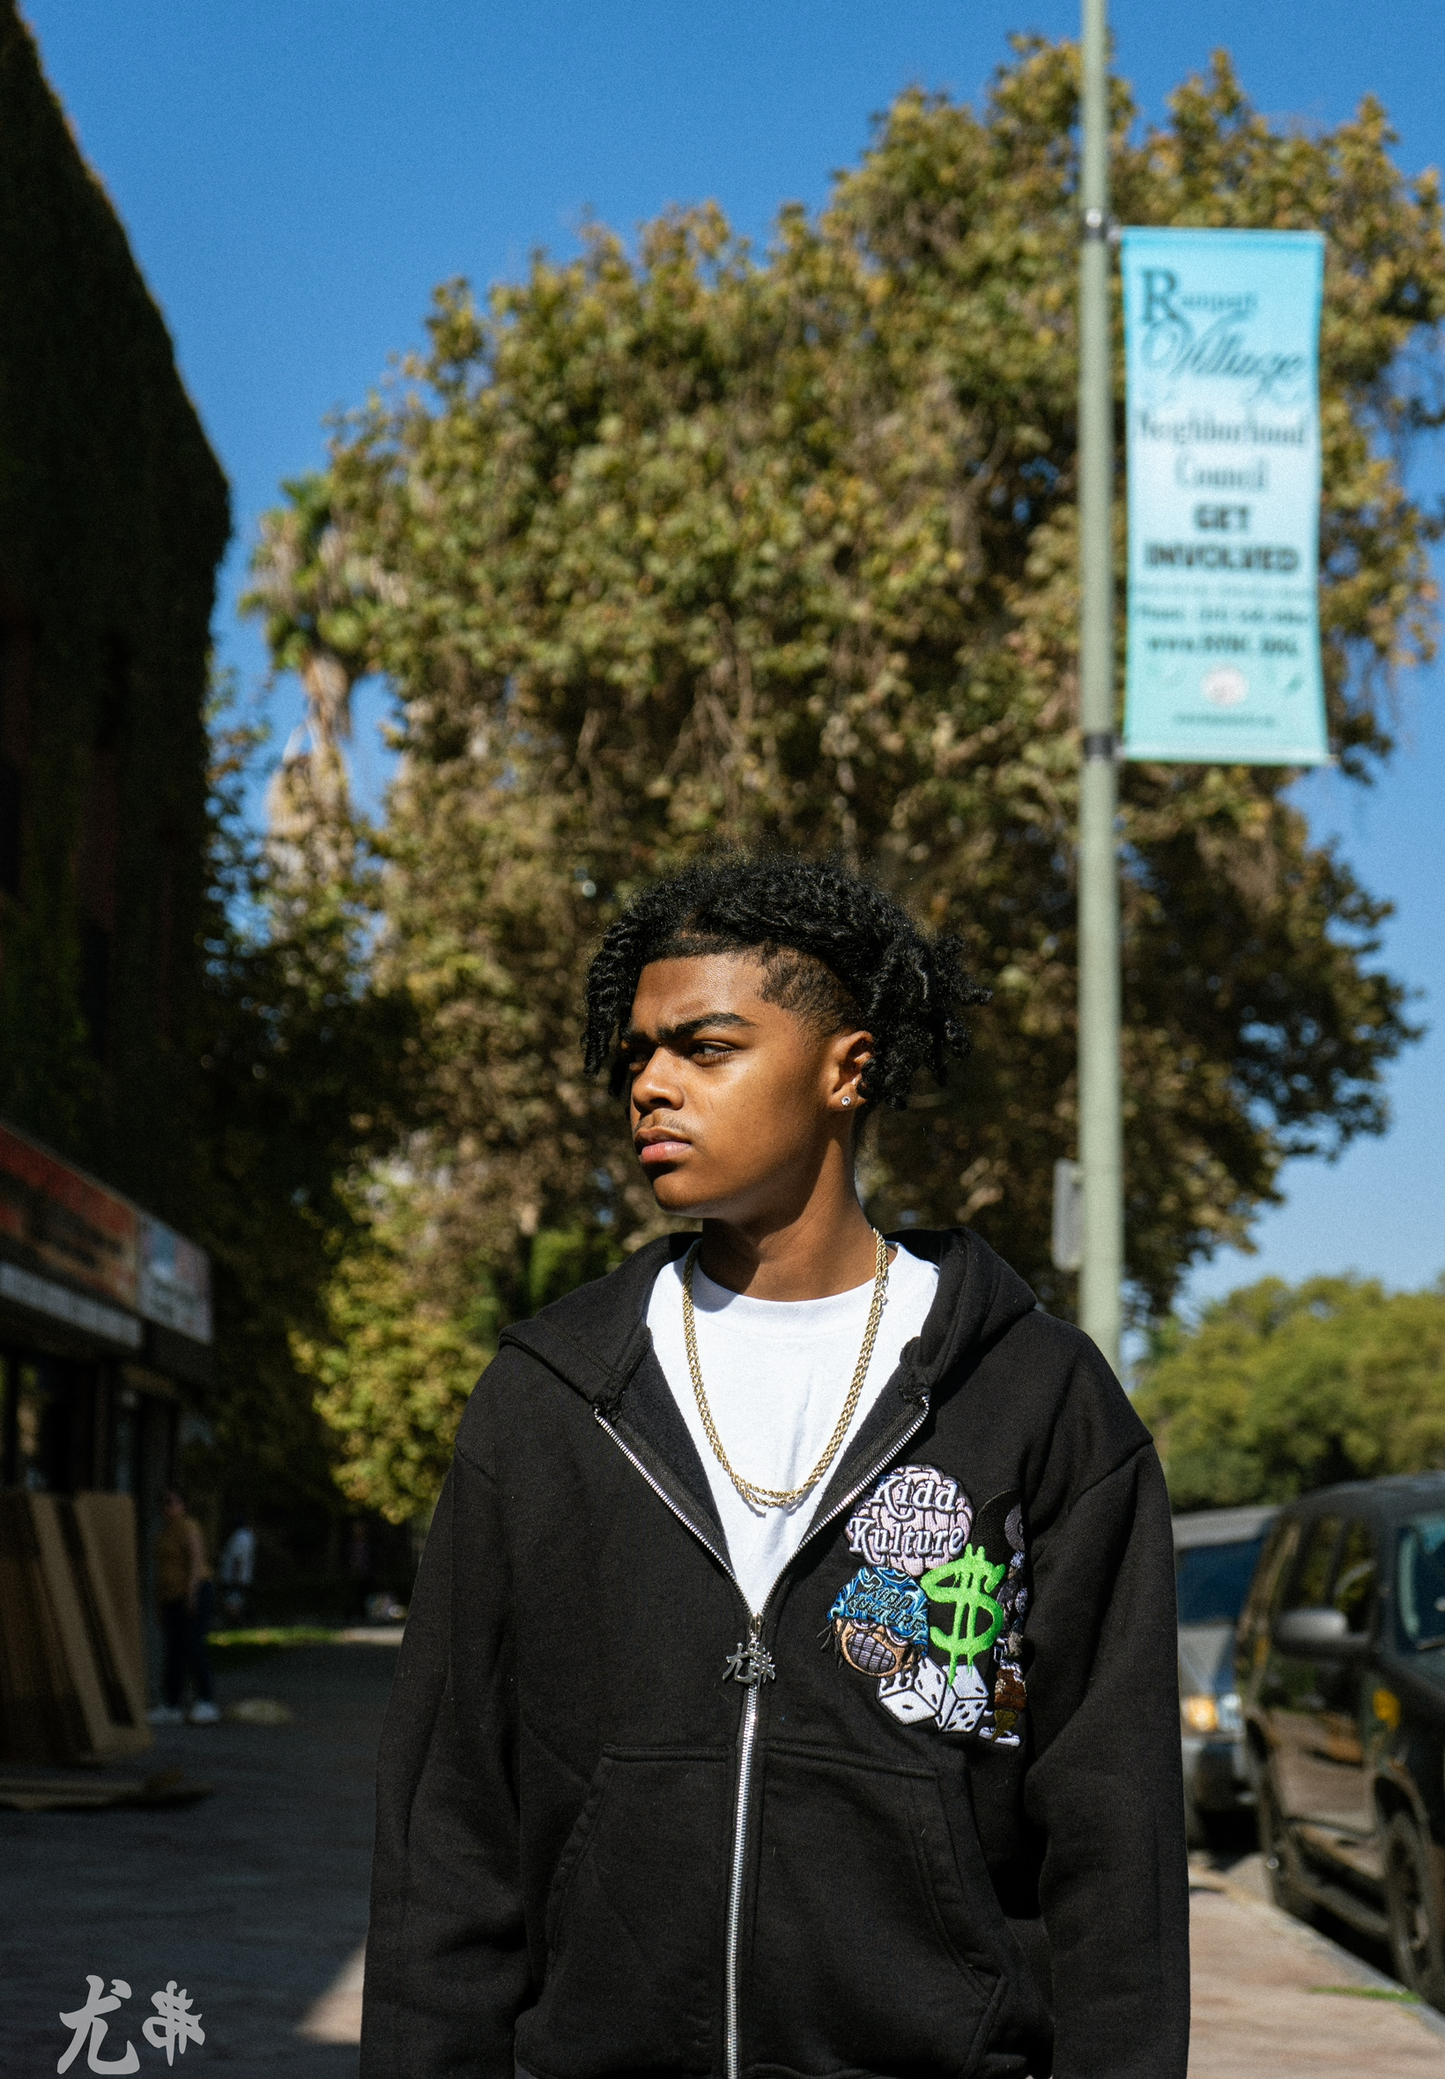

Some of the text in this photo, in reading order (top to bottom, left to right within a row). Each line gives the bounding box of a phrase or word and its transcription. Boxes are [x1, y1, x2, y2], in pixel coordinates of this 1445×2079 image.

[1141, 309, 1304, 402] Village
[1193, 503, 1250, 531] GET
[1144, 543, 1300, 574] INVOLVED
[868, 1474, 958, 1520] Kidd
[849, 1516, 964, 1566] Kulture
[844, 1594, 926, 1633] KULTURE
[865, 1583, 913, 1612] KIDD
